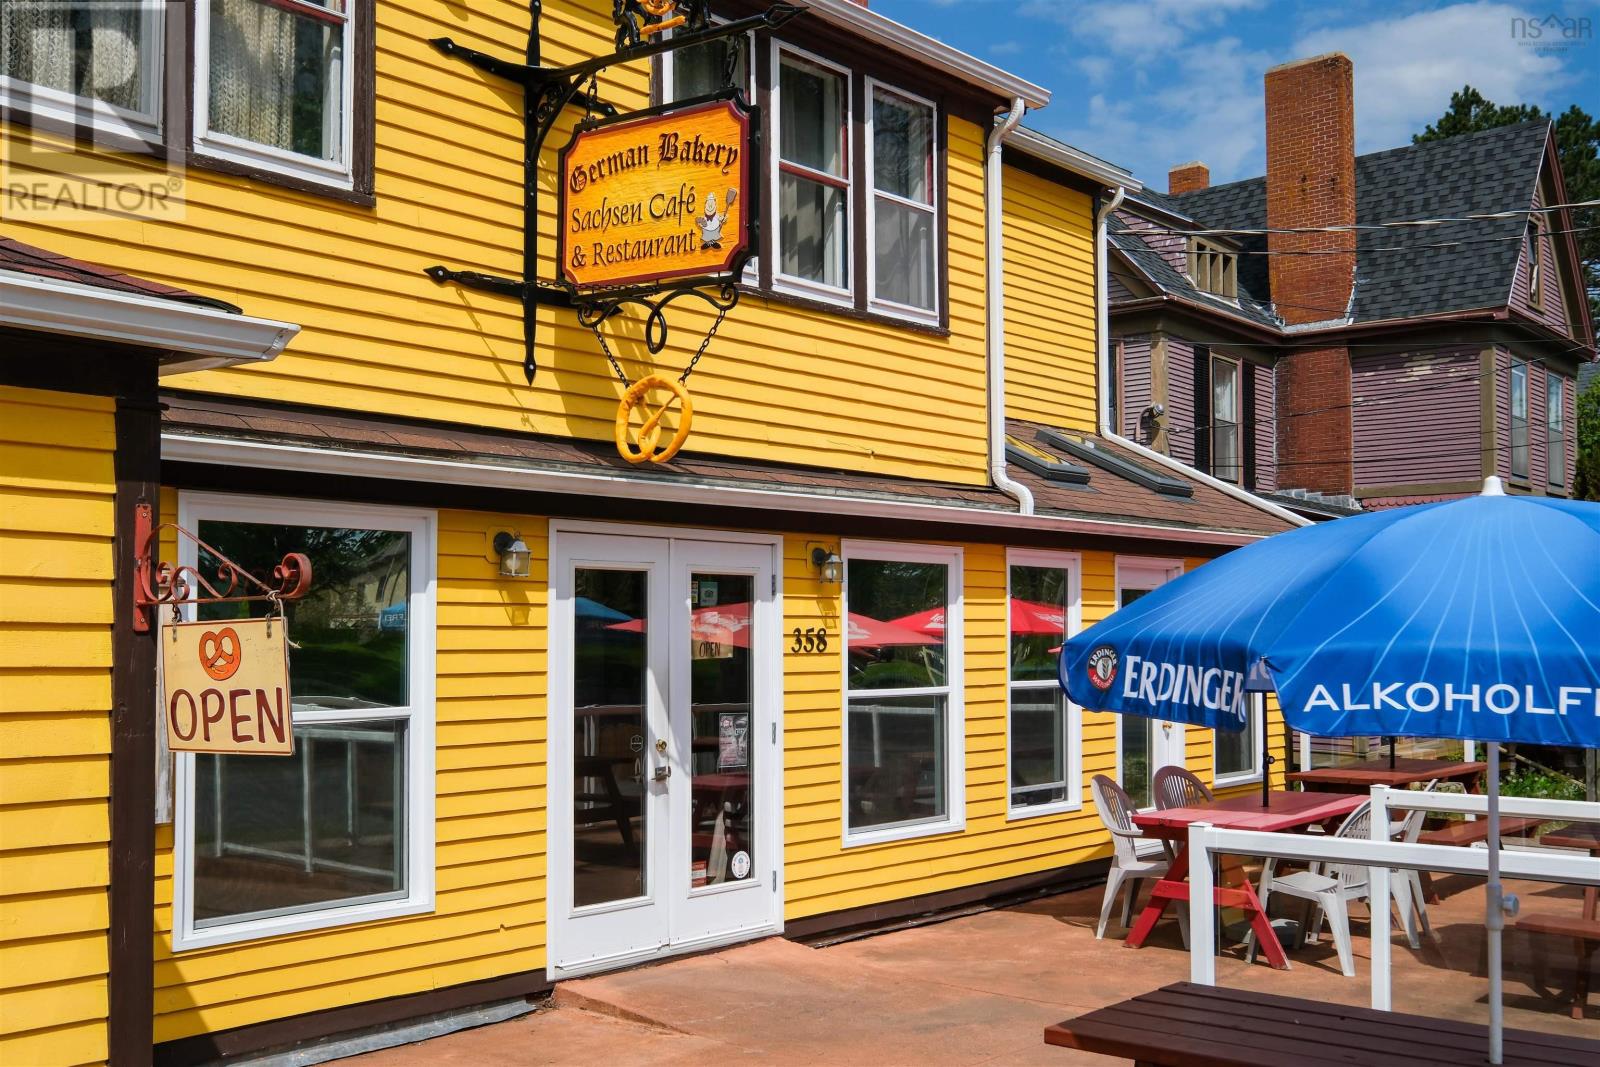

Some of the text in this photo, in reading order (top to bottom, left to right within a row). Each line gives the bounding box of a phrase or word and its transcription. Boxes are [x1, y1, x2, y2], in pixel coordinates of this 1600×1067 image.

[570, 131, 739, 194] German Bakery
[571, 182, 697, 233] Sachsen Café
[571, 229, 697, 268] & Restaurant
[699, 641, 721, 658] OPEN
[791, 627, 828, 653] 358
[170, 686, 286, 743] OPEN
[1302, 681, 1600, 717] ALKOHOLF
